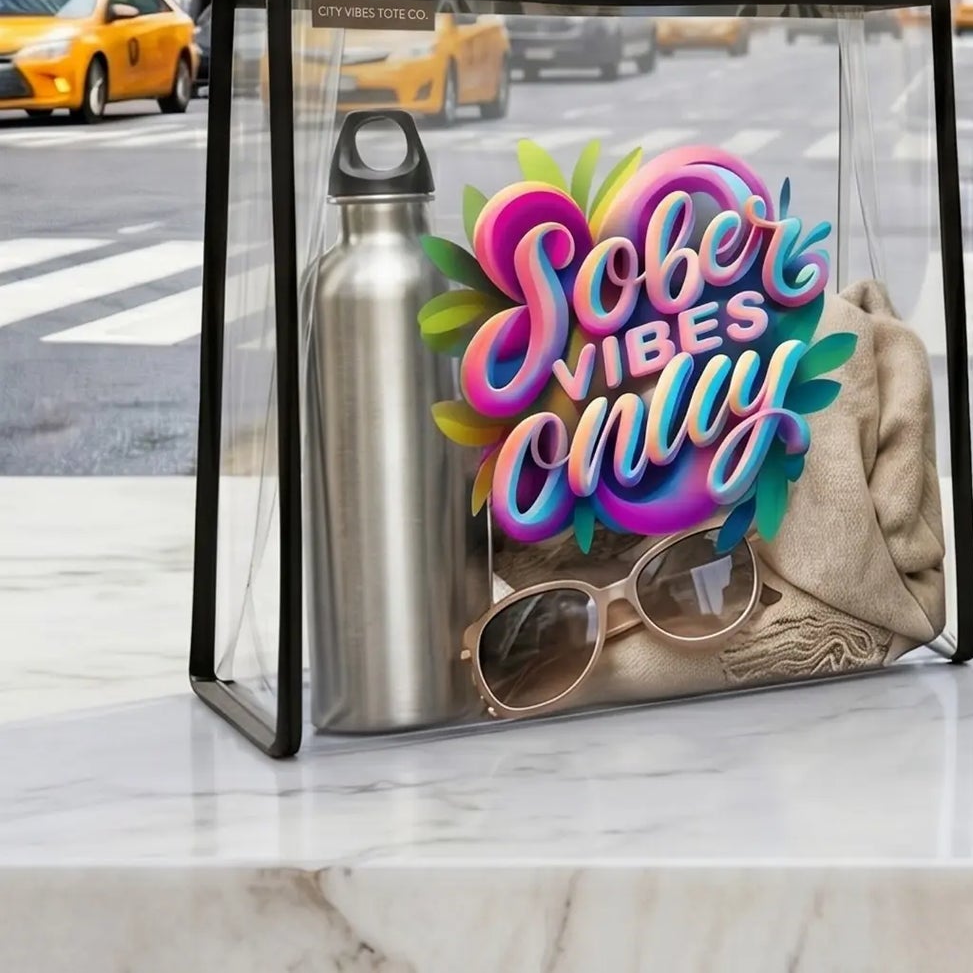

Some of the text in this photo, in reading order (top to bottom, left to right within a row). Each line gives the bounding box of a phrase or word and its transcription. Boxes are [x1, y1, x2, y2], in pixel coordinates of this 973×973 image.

[318, 5, 429, 20] CITY VIBES TOTE CO.
[460, 190, 831, 418] Sober
[552, 290, 769, 401] VIBES
